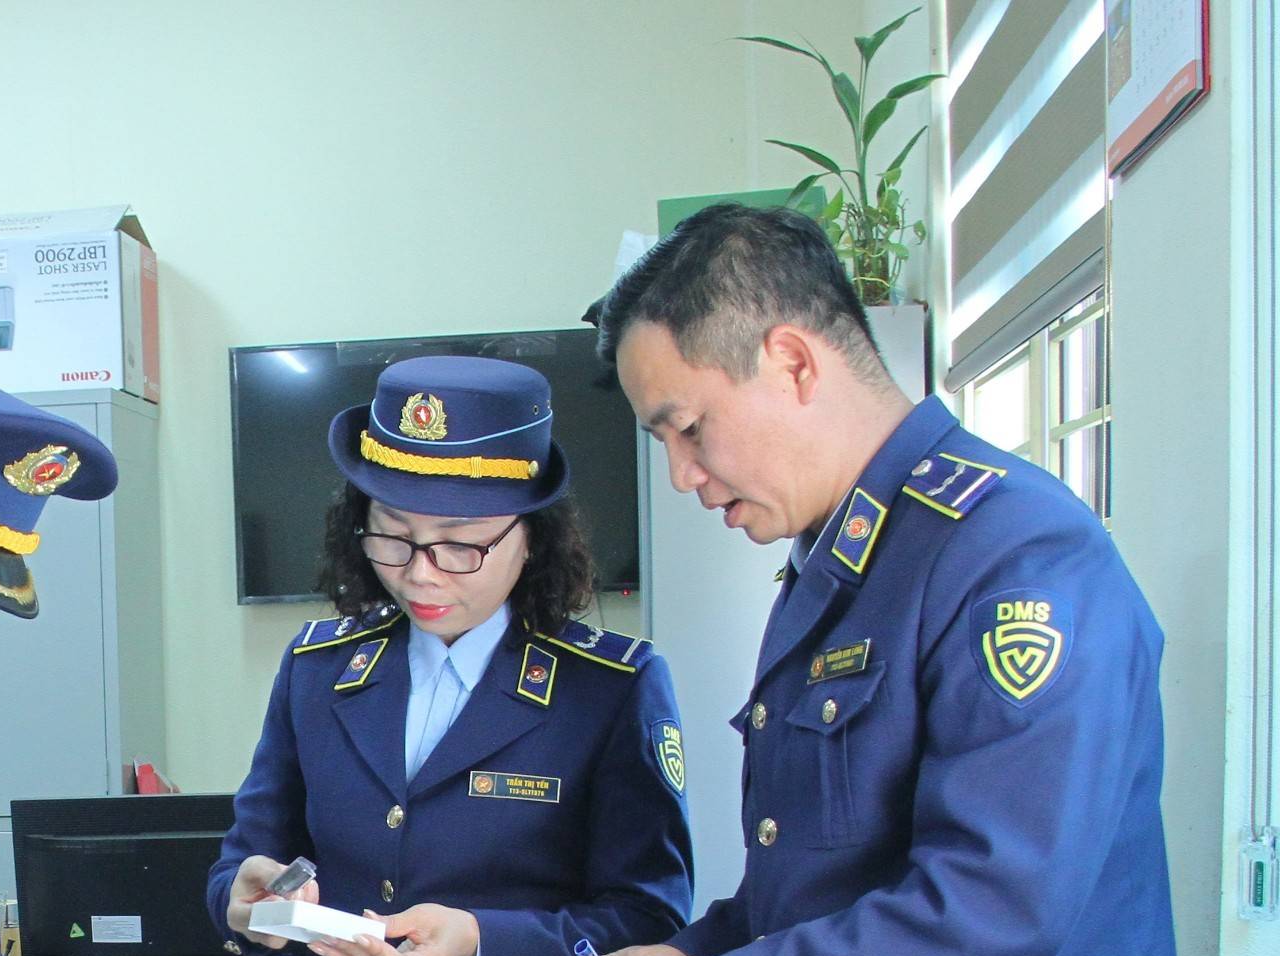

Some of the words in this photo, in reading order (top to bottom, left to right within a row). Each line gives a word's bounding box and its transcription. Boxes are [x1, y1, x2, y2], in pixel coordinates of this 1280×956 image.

[38, 263, 70, 275] SHOT
[73, 261, 107, 273] LASER
[62, 369, 112, 382] Canon
[996, 600, 1051, 623] DMS
[663, 725, 681, 744] DMS
